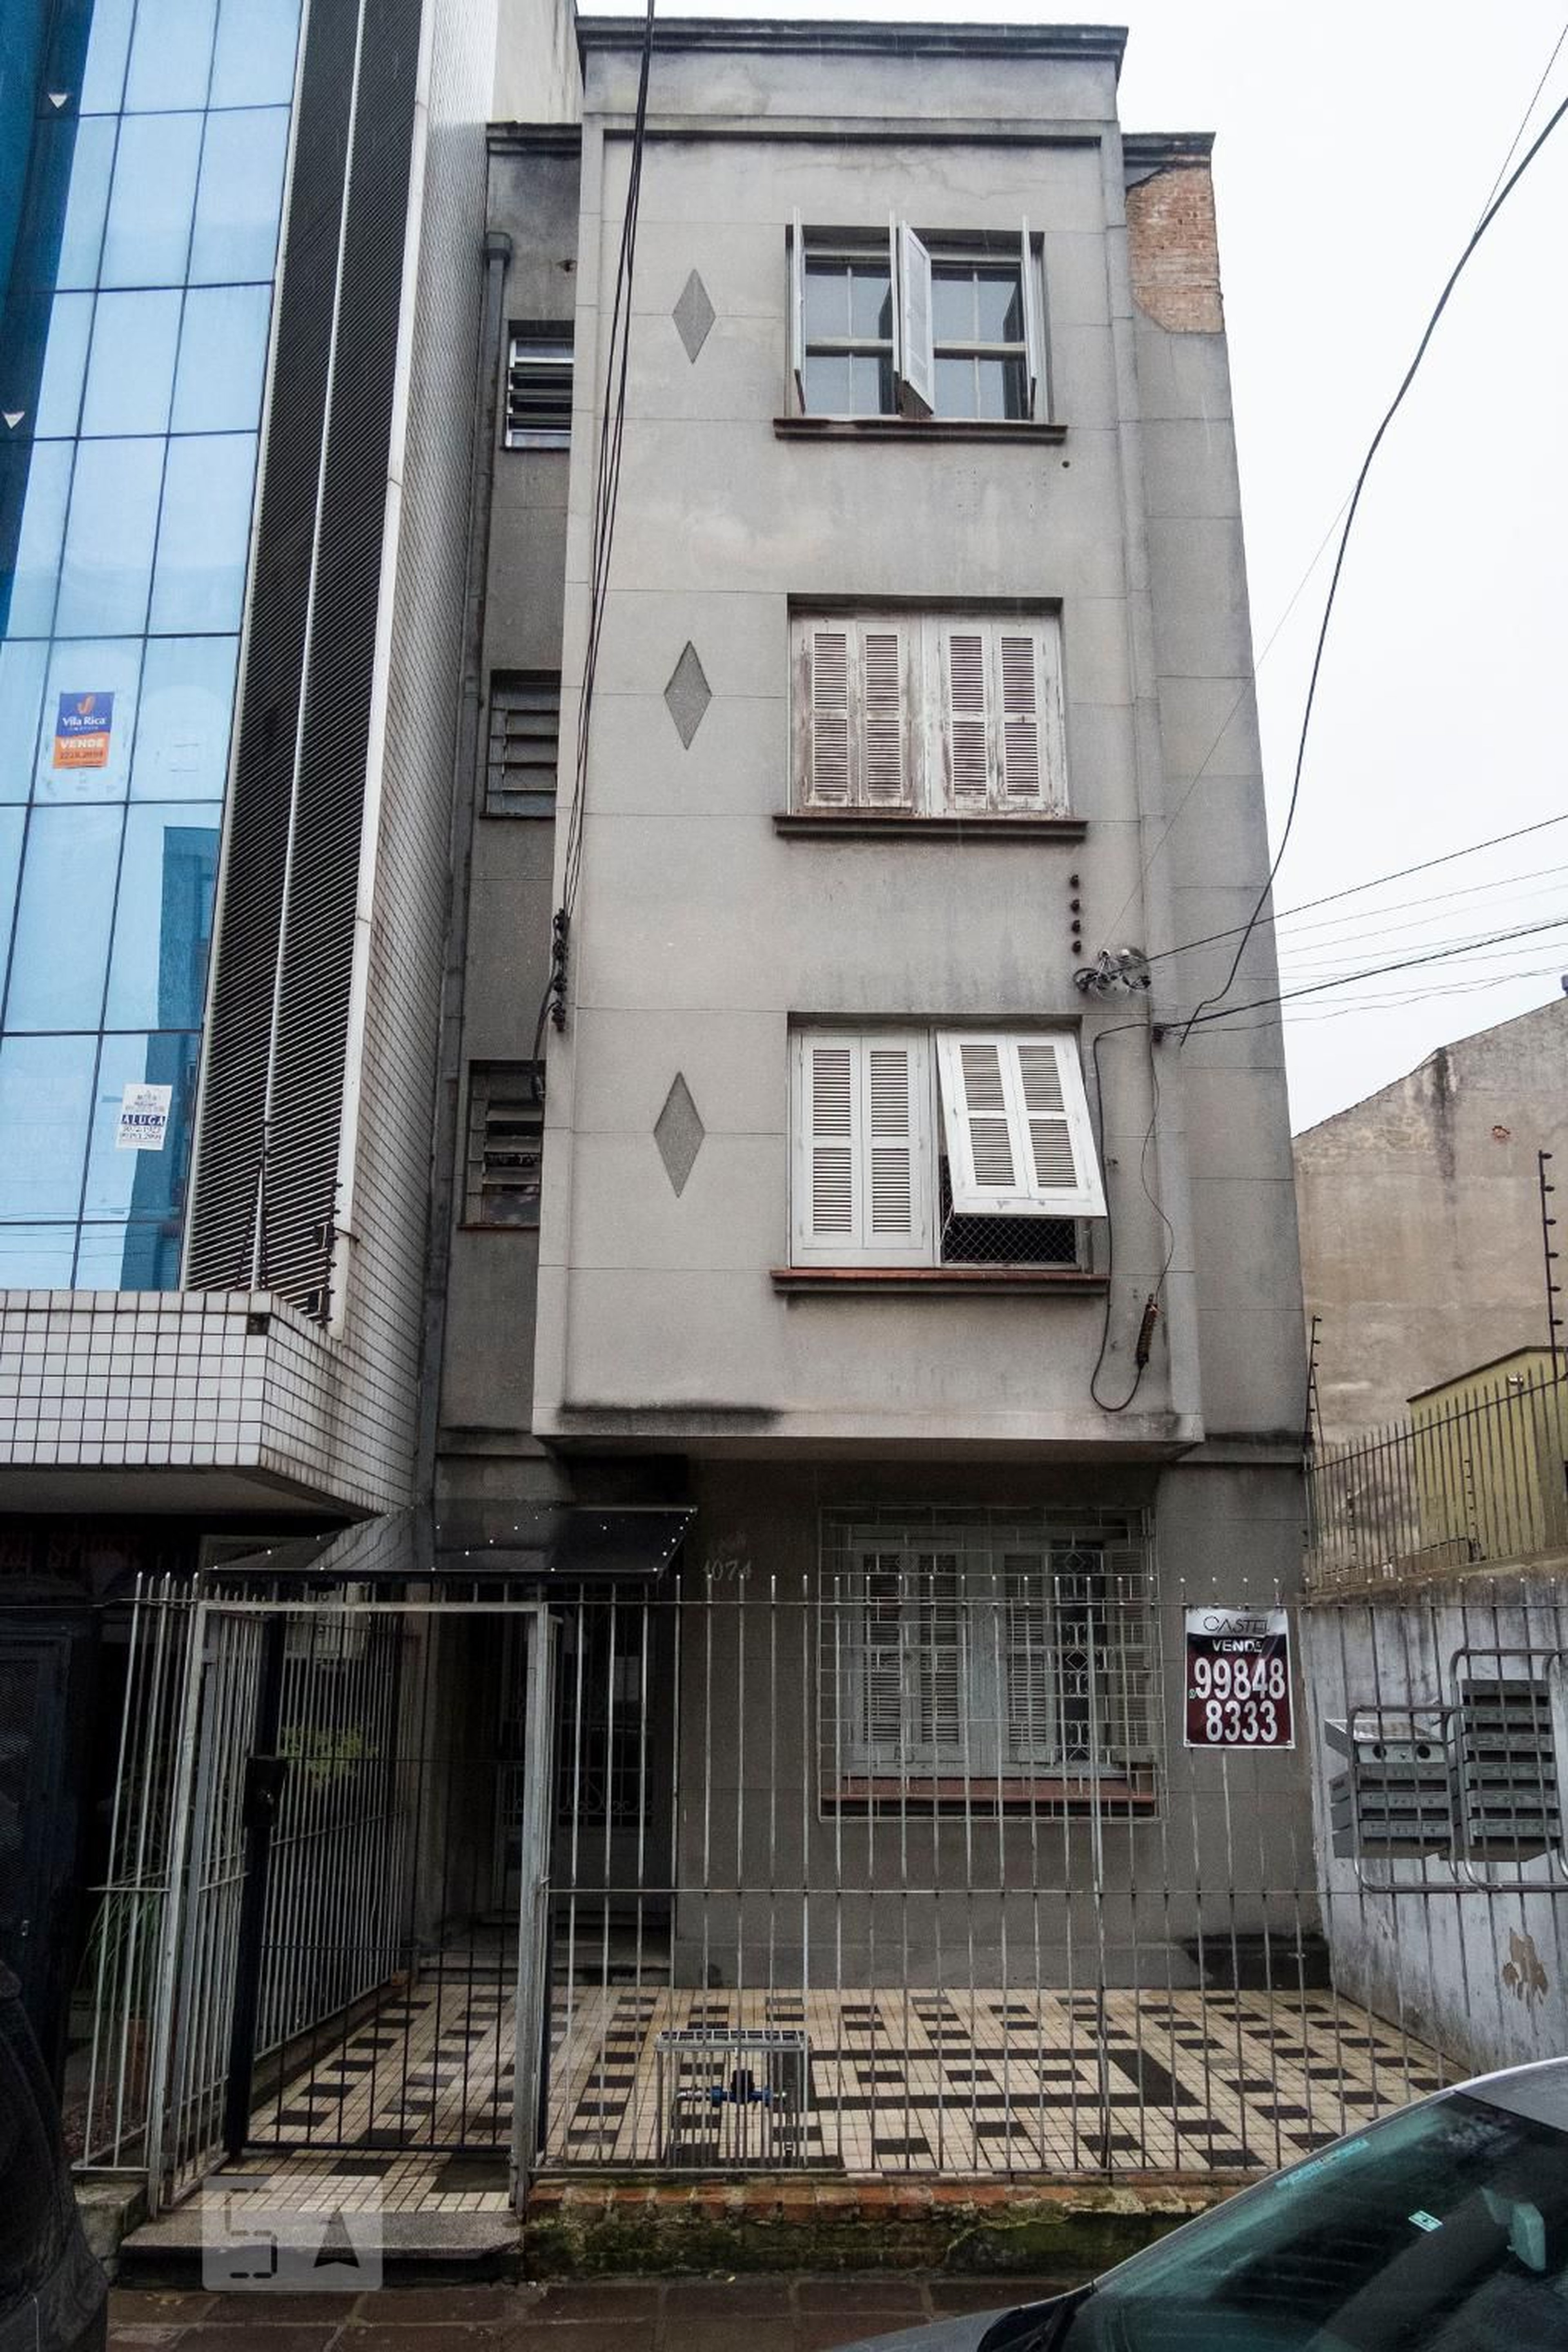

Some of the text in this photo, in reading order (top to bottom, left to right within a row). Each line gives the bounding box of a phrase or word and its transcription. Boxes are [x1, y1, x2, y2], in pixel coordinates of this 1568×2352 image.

[62, 716, 105, 726] Vila Rica
[60, 738, 104, 748] VENDE
[122, 1115, 164, 1125] ALUGA
[1212, 1639, 1263, 1653] VENDE
[1194, 1657, 1285, 1700] 99848
[1206, 1700, 1278, 1742] 8333
